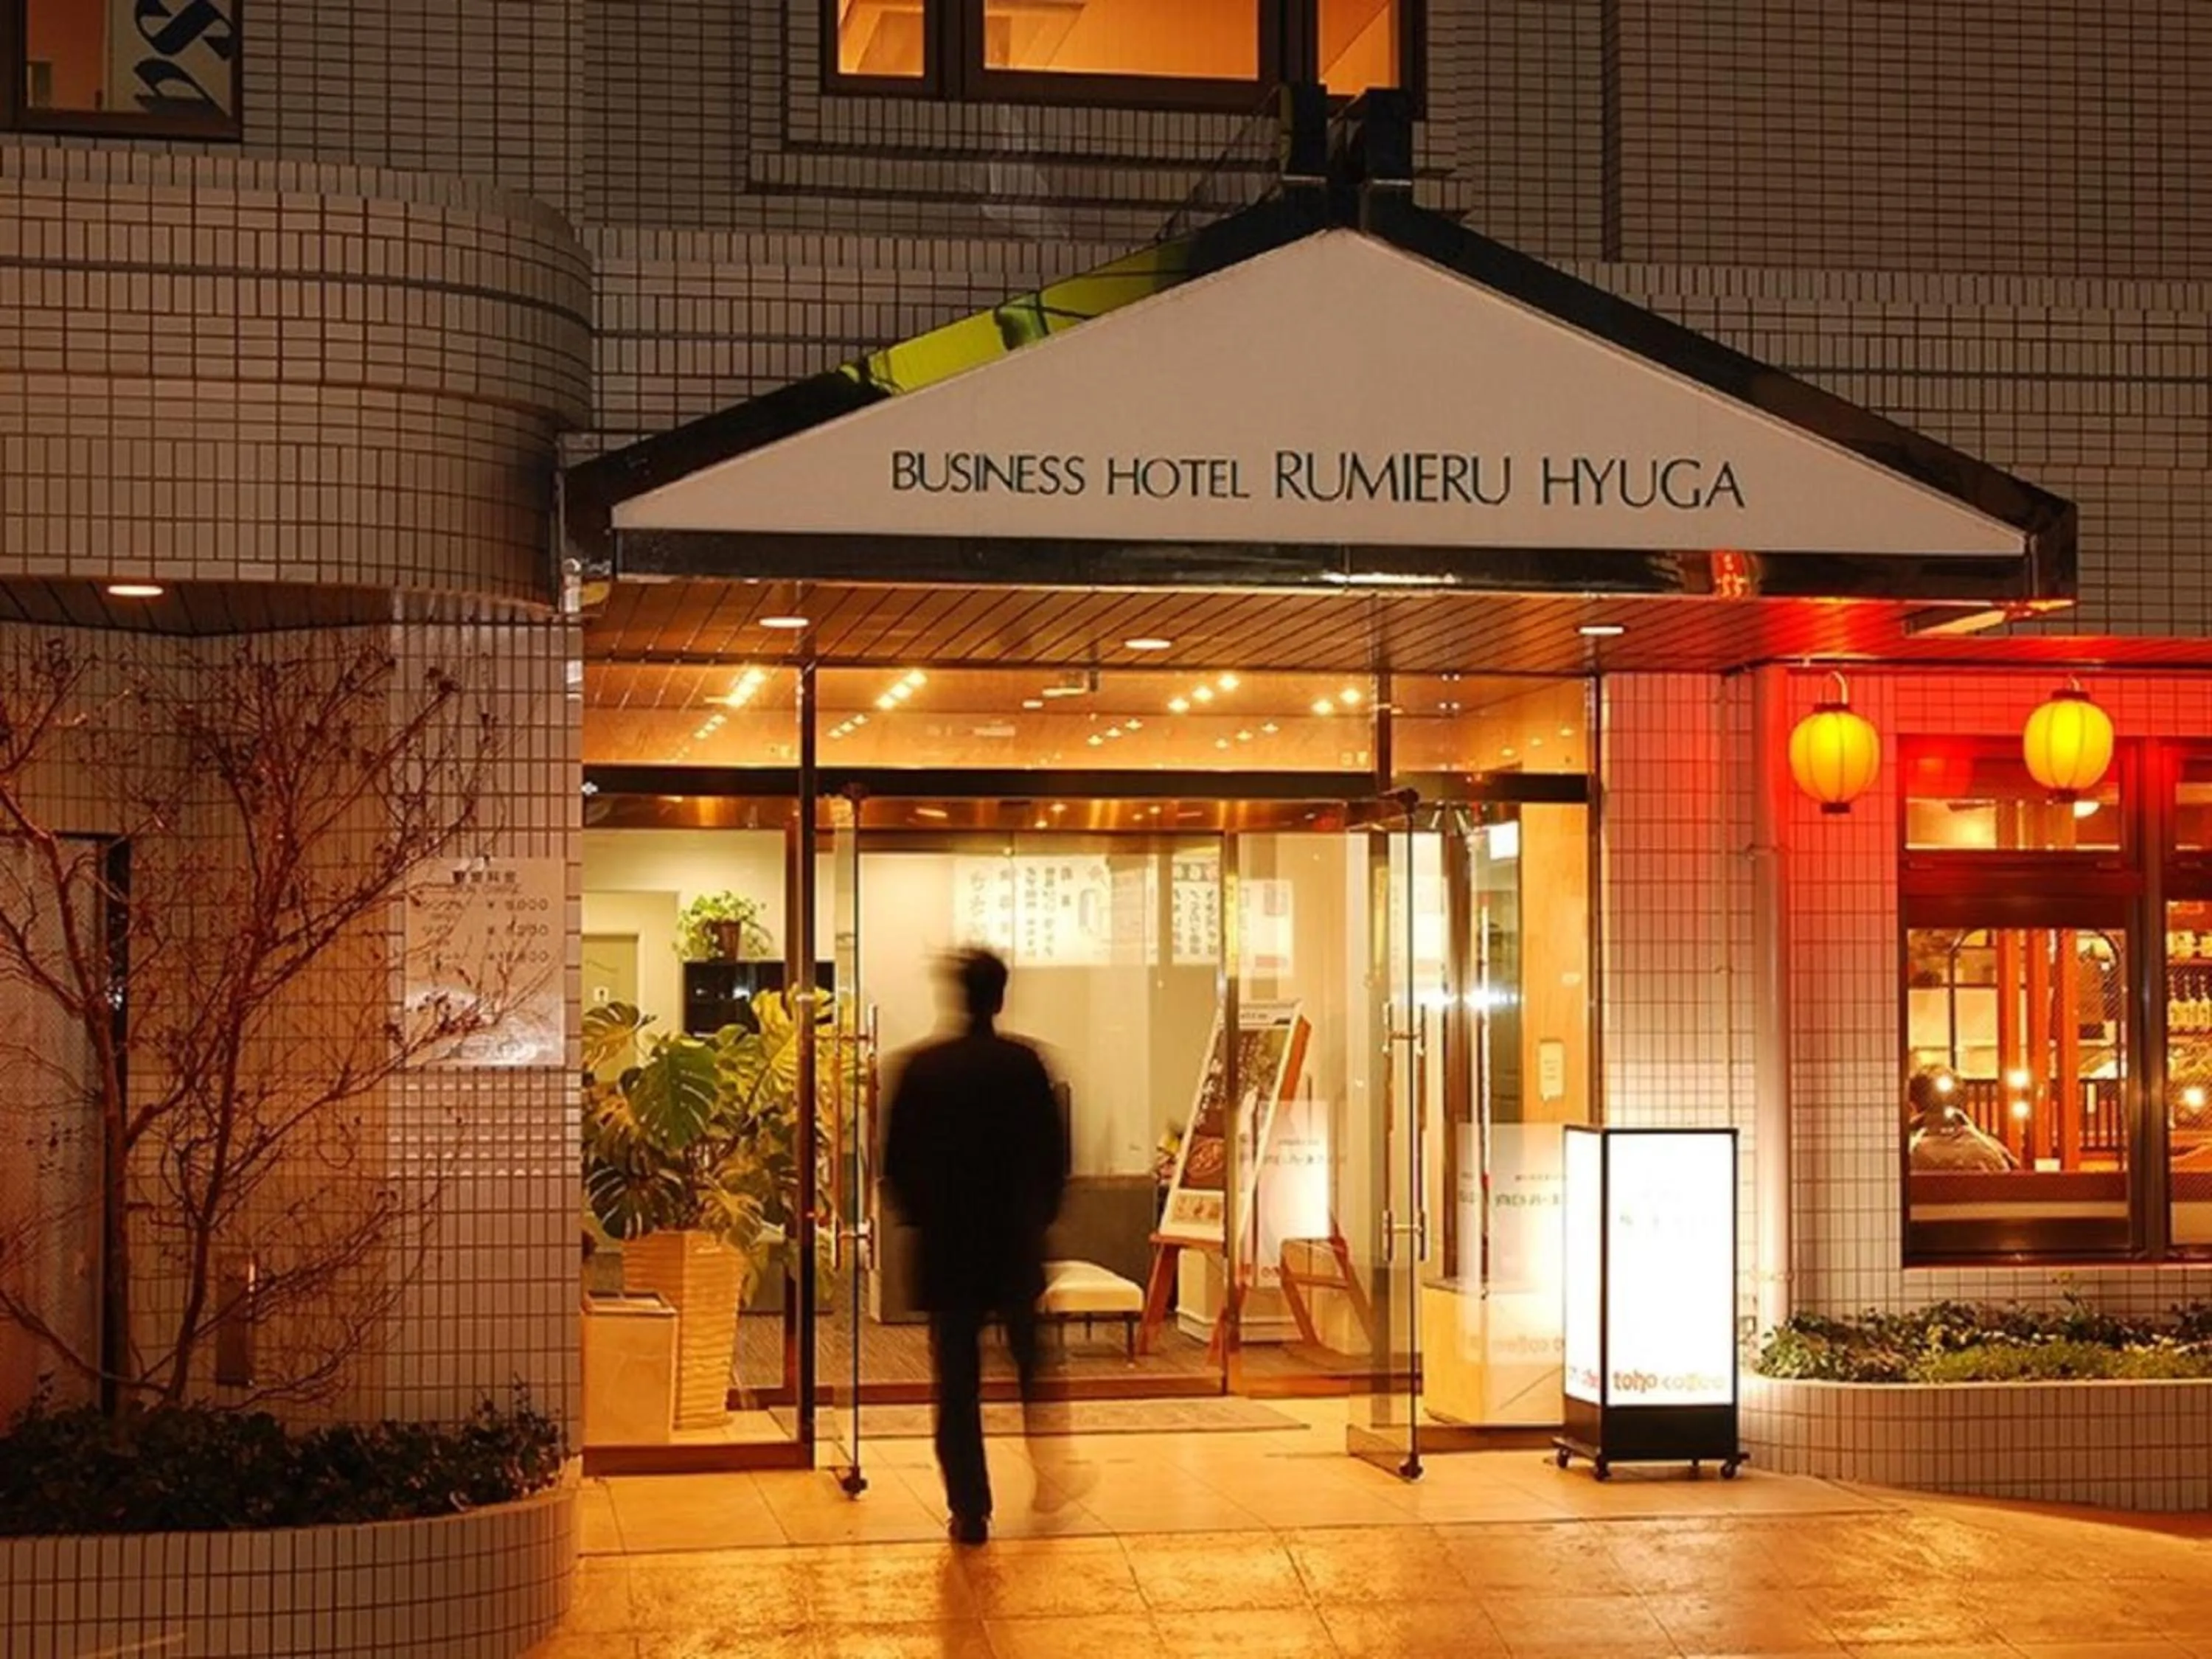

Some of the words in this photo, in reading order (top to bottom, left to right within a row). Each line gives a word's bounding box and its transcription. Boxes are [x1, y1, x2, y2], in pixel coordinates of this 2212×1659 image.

[891, 450, 1087, 496] BUSINESS
[1107, 457, 1252, 499] HOTEL
[1275, 450, 1512, 506] RUMIERU
[1542, 456, 1747, 510] HYUGA
